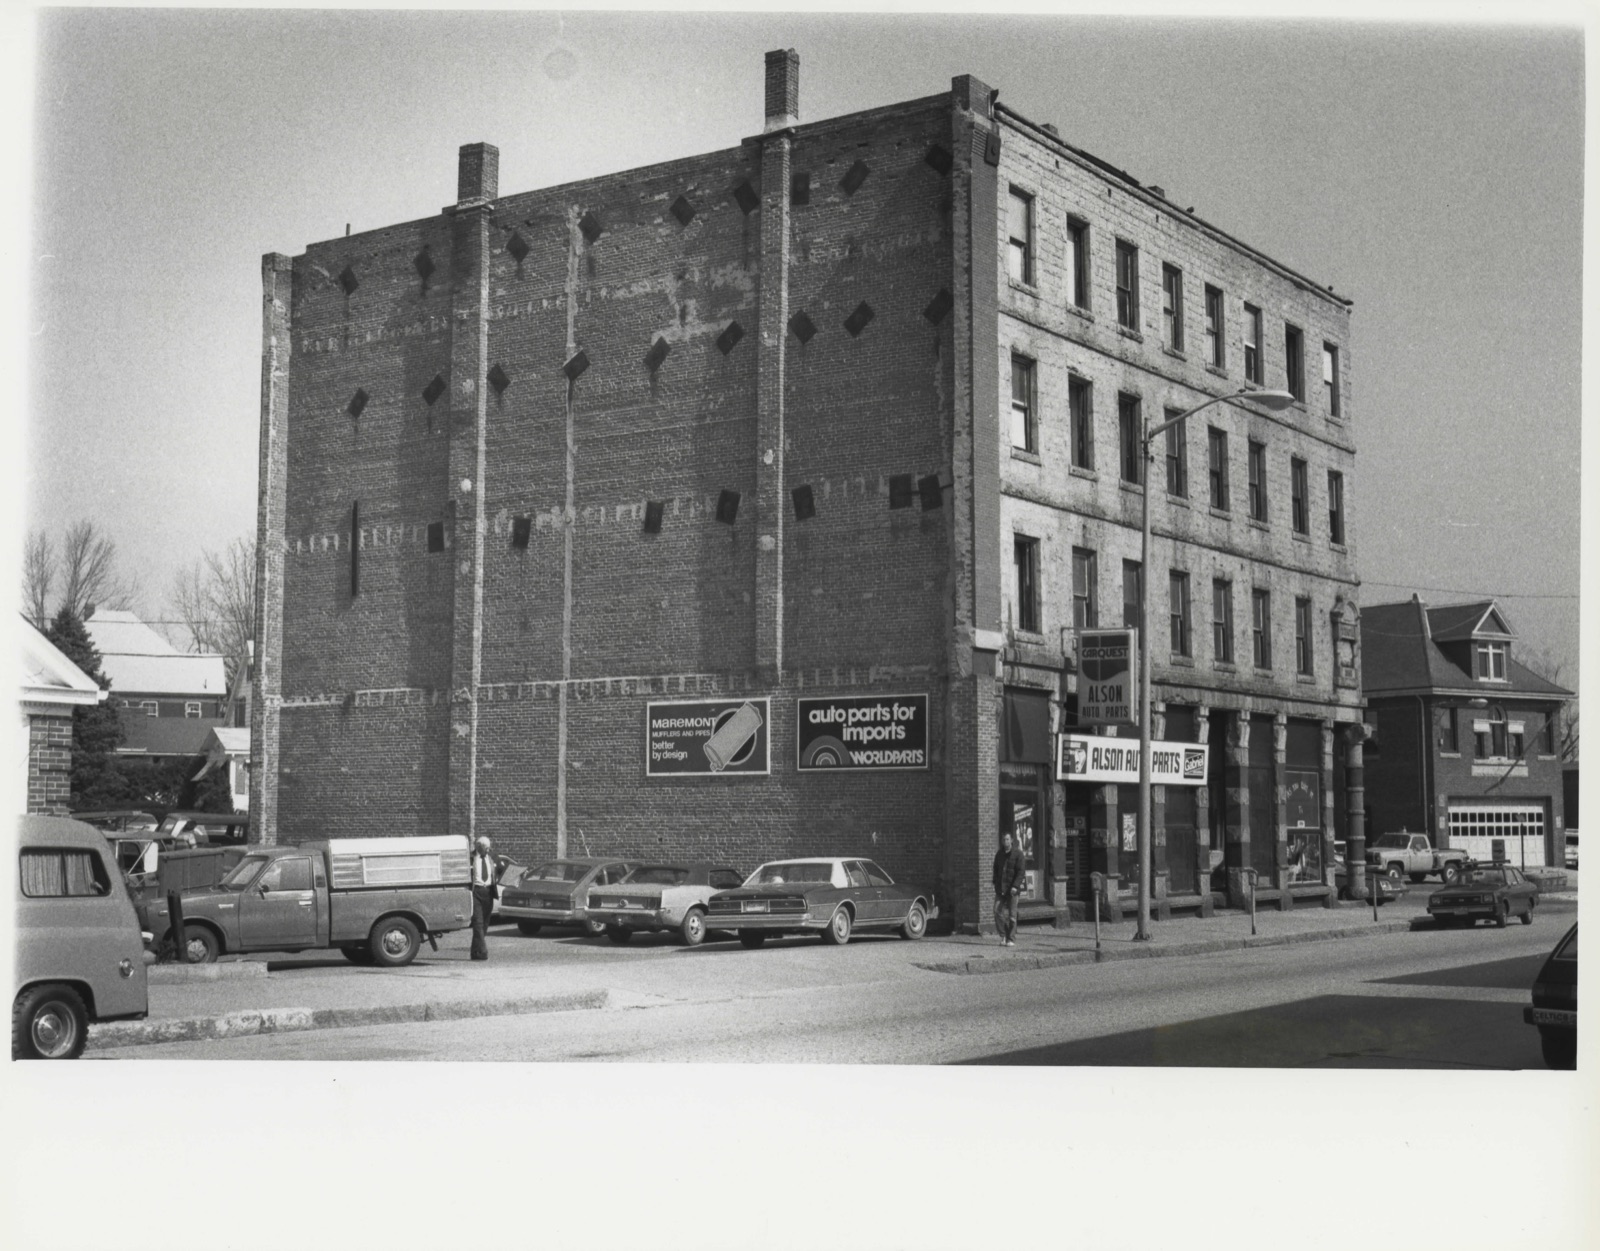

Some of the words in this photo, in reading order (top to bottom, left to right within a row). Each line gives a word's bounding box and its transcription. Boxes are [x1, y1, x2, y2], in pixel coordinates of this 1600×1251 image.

[1082, 647, 1129, 659] CARQUEST
[1088, 684, 1123, 703] ALSON
[809, 705, 847, 723] auto
[848, 703, 891, 726] parts
[892, 702, 916, 720] for
[1082, 706, 1100, 718] AUTO
[1105, 705, 1129, 718] PARTS
[652, 730, 681, 738] MUFFLERS
[695, 729, 711, 737] PIPES
[842, 722, 906, 744] imports
[652, 741, 675, 750] better
[652, 752, 662, 761] by
[662, 751, 688, 760] design
[849, 749, 924, 764] WORLDPARTS
[1091, 747, 1124, 771] ALSON
[1125, 749, 1140, 772] AU
[1152, 751, 1180, 774] PARTS
